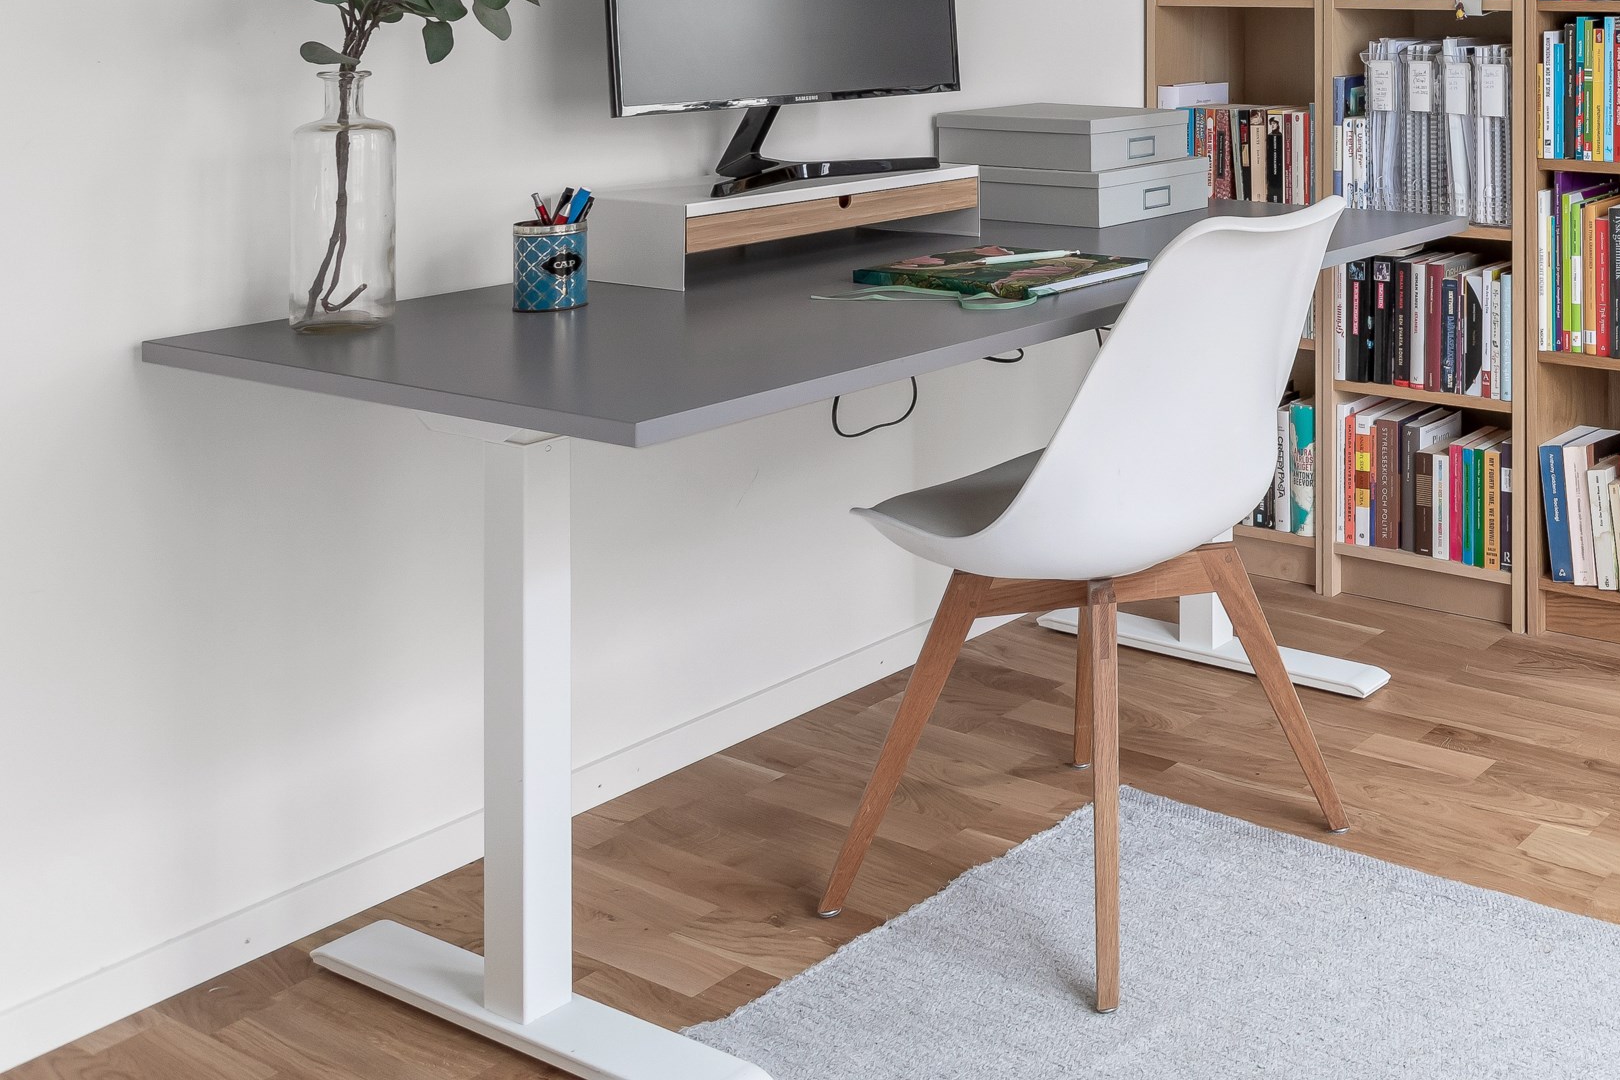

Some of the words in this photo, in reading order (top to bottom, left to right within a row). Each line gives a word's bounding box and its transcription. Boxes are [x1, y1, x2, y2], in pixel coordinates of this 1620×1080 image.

[795, 94, 819, 102] SAMSUNG
[552, 259, 576, 270] CAP
[1293, 448, 1312, 456] ANDRA
[1380, 427, 1388, 485] STYRELSESKICK
[1488, 457, 1495, 467] MY
[1277, 436, 1286, 499] CREEPYPASTA
[1293, 471, 1314, 480] ANTONY
[1293, 477, 1314, 487] BEEVOR
[1380, 487, 1388, 507] OCH
[1487, 491, 1495, 506] TIME,
[1488, 508, 1495, 518] WE
[1380, 508, 1388, 539] POLITIK
